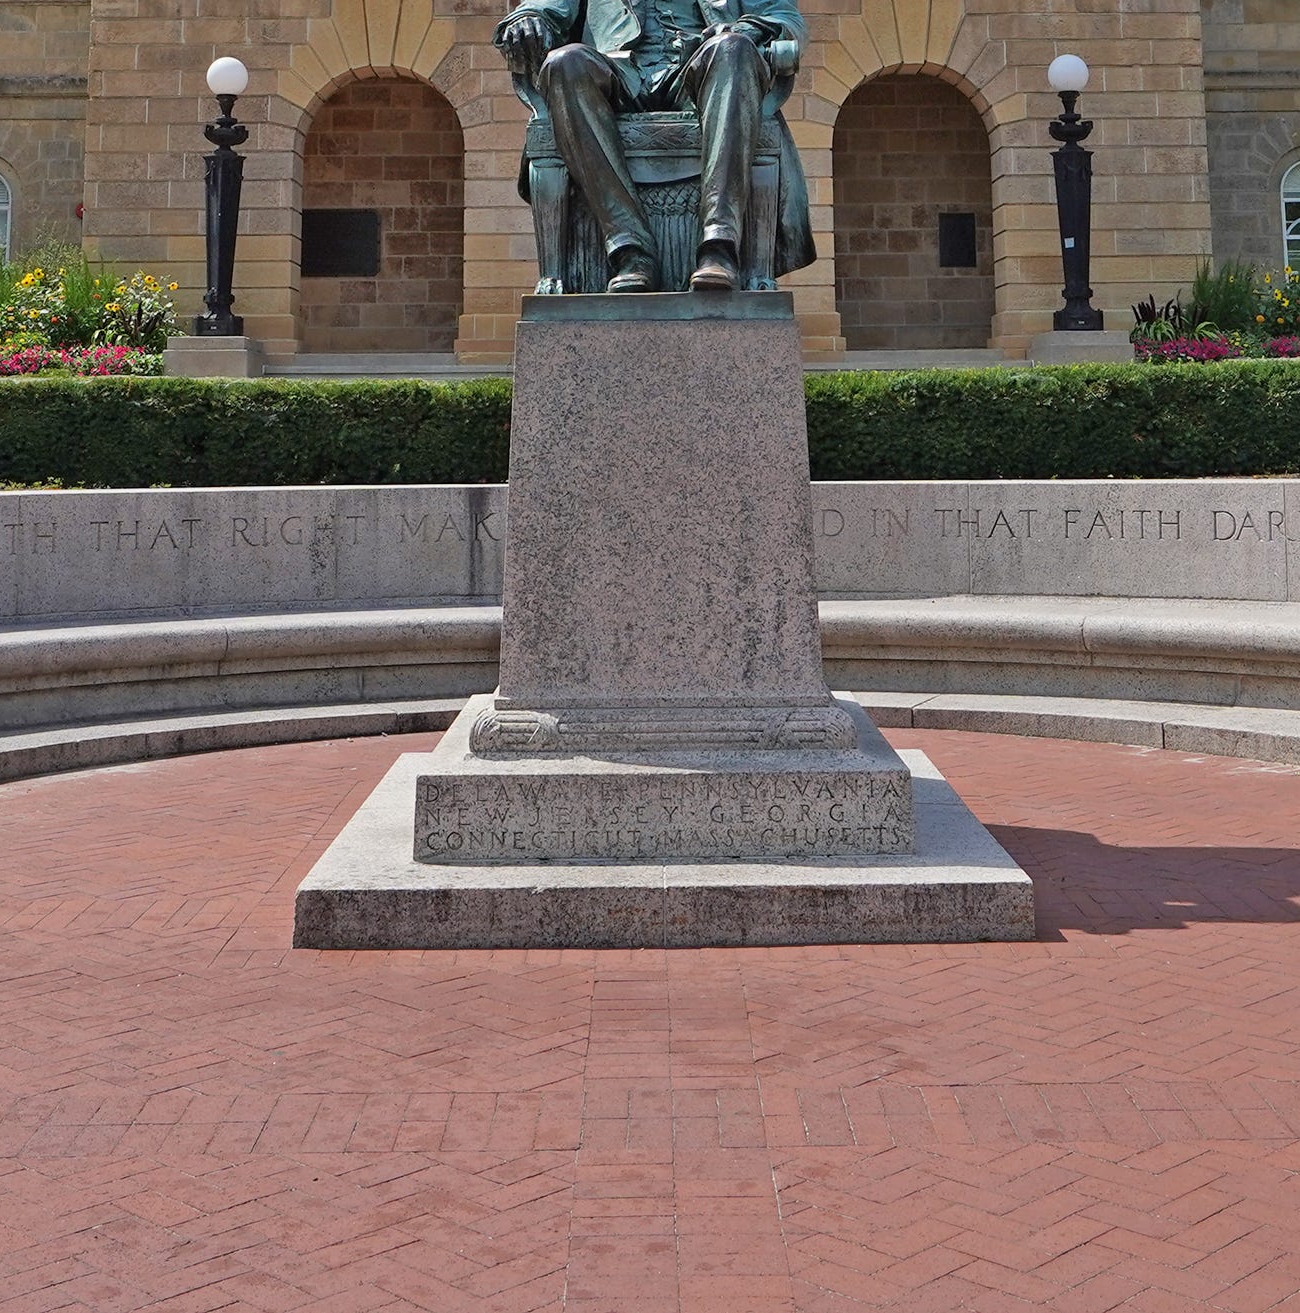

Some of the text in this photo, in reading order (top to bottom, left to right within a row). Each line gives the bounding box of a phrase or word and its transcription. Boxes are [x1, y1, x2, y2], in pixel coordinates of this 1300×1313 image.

[90, 518, 202, 552] THAT
[231, 515, 366, 548] RIGHT
[872, 508, 911, 538] IN
[934, 509, 1037, 539] THAT
[1064, 510, 1183, 540] FAITH
[424, 779, 901, 803] DELAWARE PENNSYLVANIA
[424, 803, 902, 827] NEW JERSEY GEORGIA
[425, 826, 901, 851] CONNECTICUT MASSACHUSETTS
